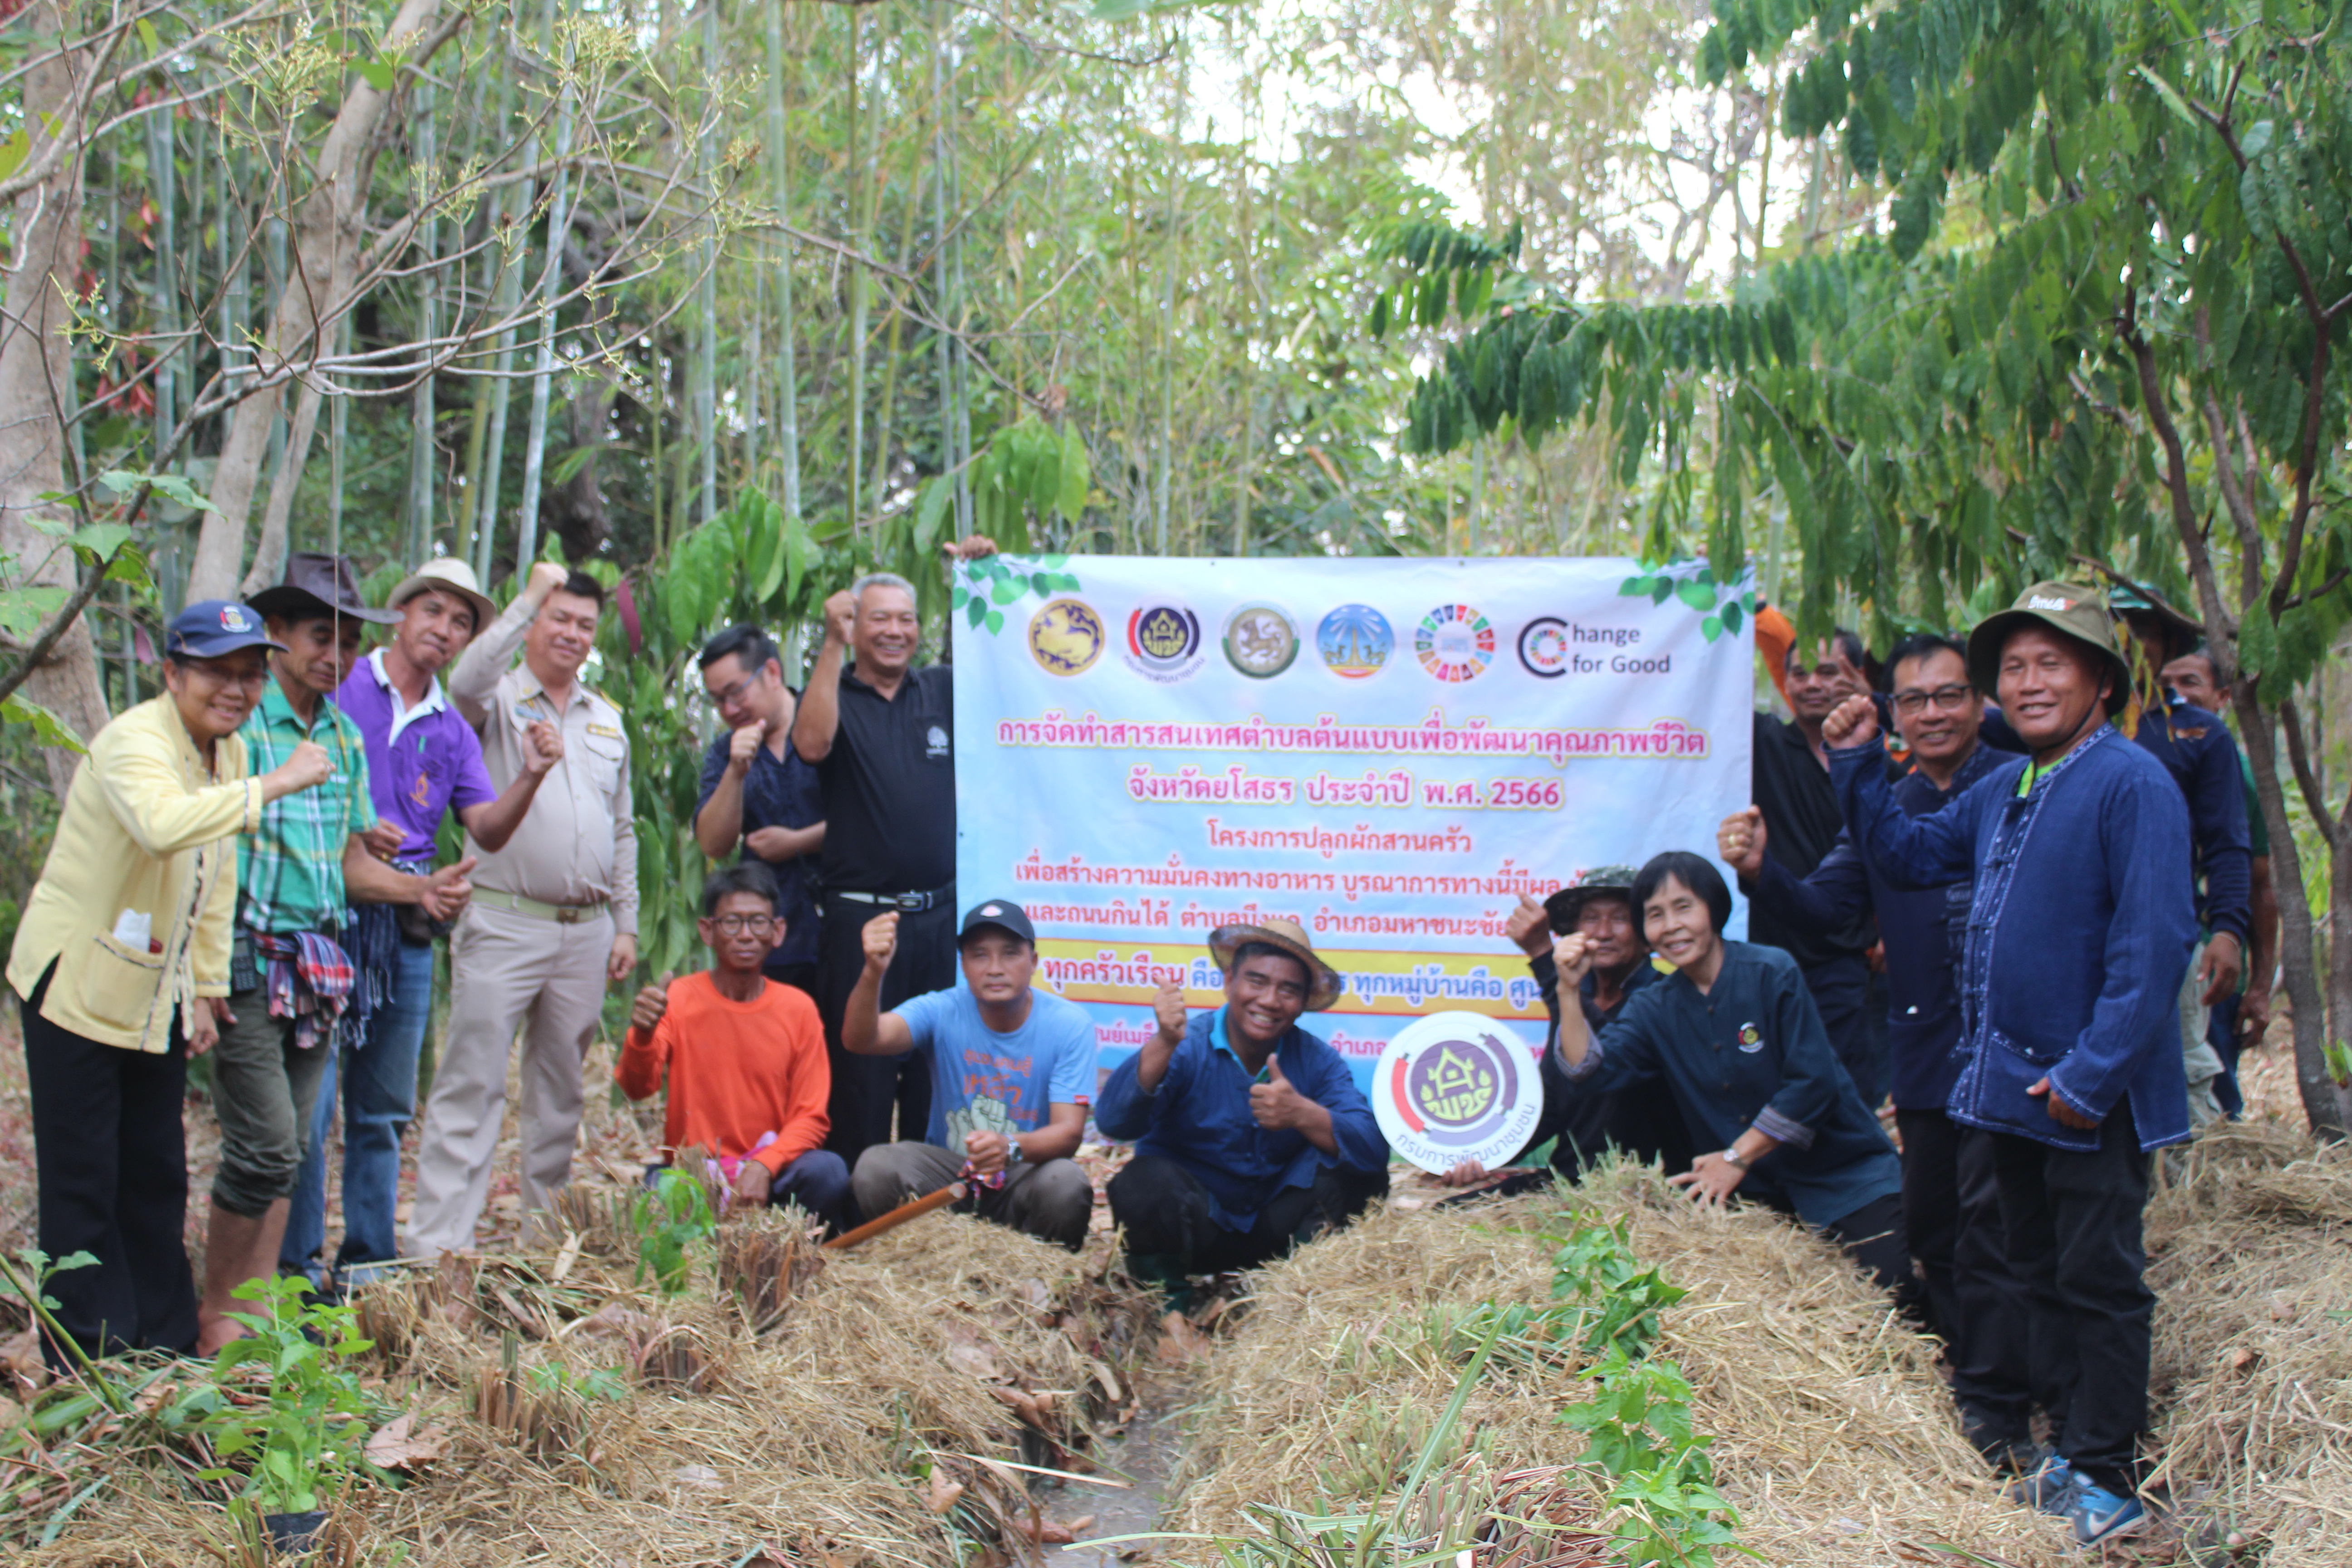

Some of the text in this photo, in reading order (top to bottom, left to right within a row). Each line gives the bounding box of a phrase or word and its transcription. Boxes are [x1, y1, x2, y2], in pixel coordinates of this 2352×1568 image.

[1573, 654, 1670, 674] for Good
[999, 711, 1705, 764] การจัดทำสารสนเทศตำบลต้นแบบเพื่อพัฒนาคุณภาพชีวิต
[1129, 767, 1559, 805] จังหวัดยโสธร ประจำปี พ.ศ. 2566
[1207, 819, 1472, 859] โครงการปลูกผักสวนครัว
[1016, 849, 1334, 890] เพื่อสร้างความมั่นคงทางอาหาร
[1044, 953, 1184, 990] ทุกครัวเรือน
[1354, 964, 1503, 1004] ทุกหมู่บ้านคือ
